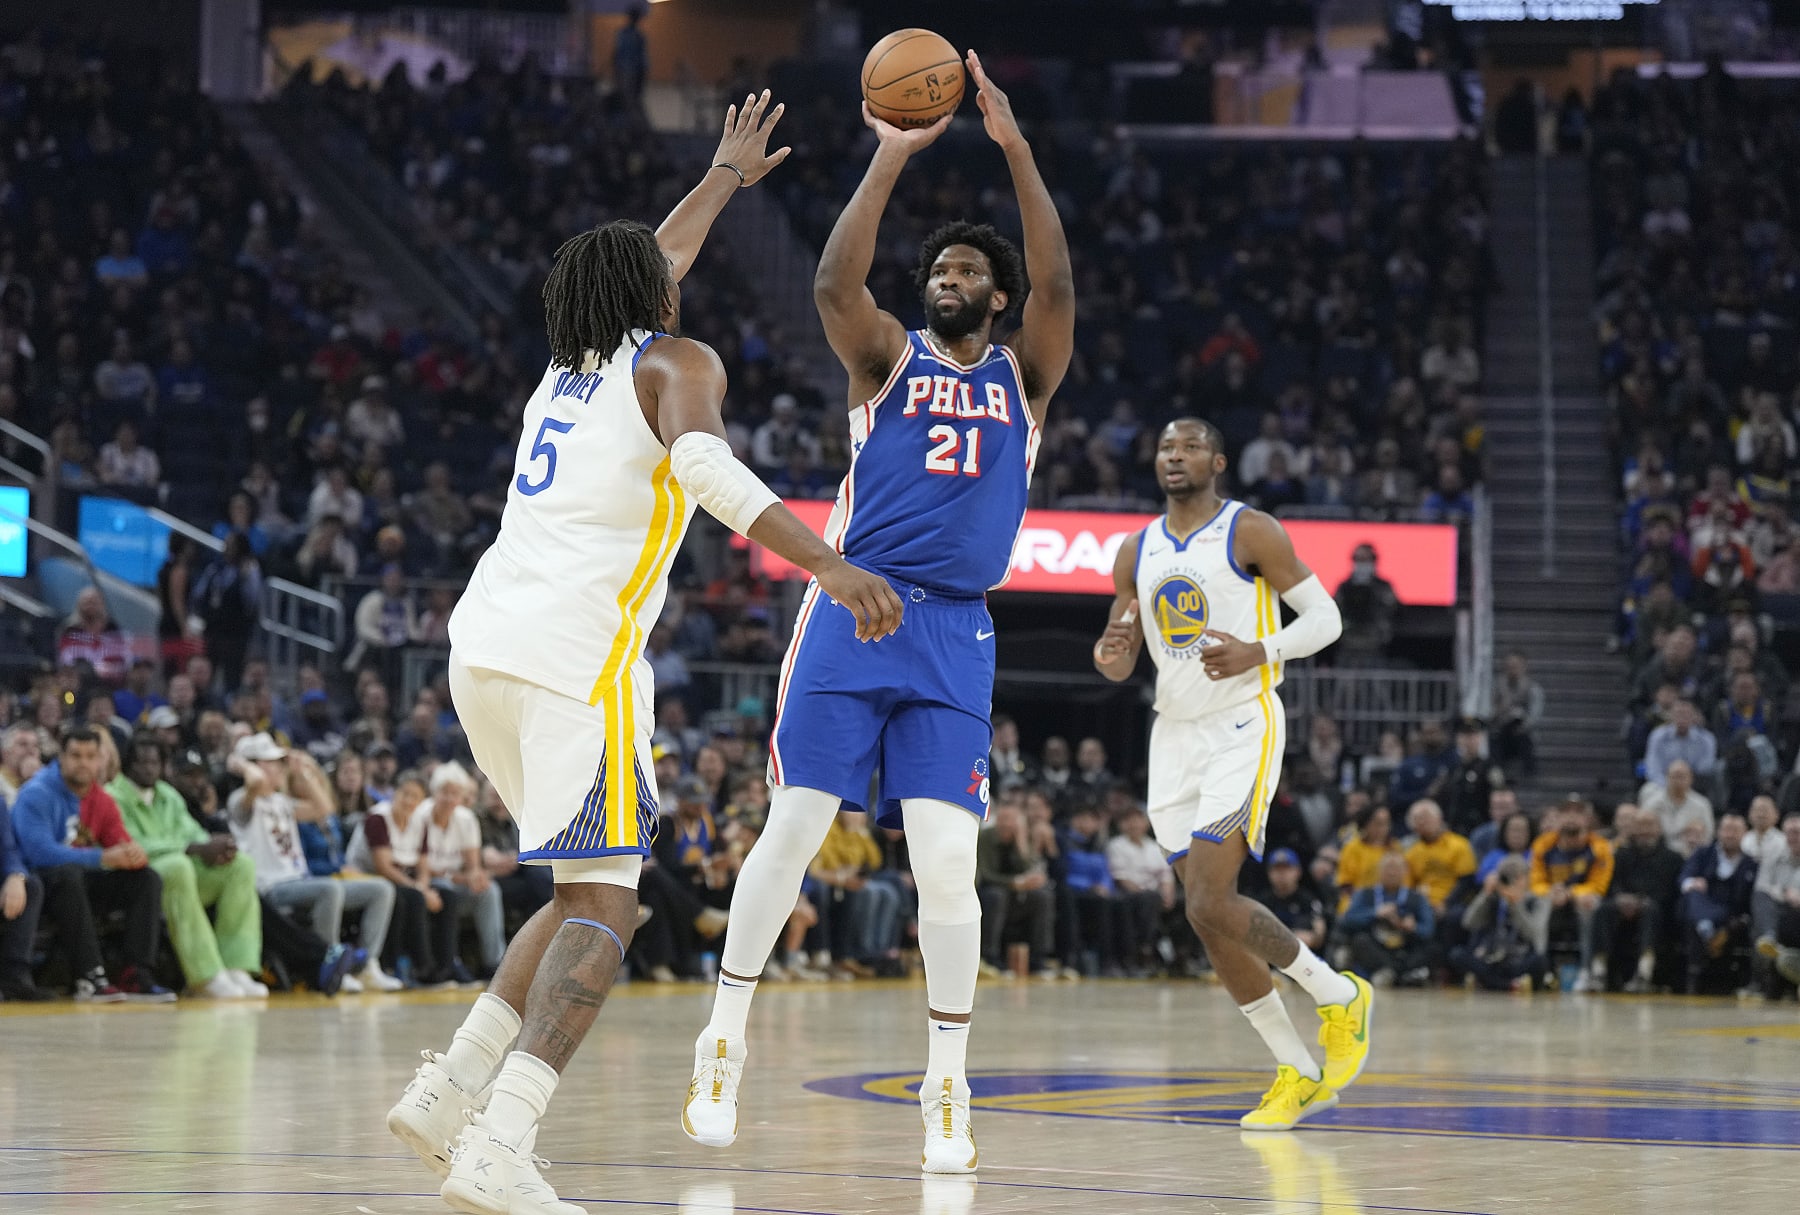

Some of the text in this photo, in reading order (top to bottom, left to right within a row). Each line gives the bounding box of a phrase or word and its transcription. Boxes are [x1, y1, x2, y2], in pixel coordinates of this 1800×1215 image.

[903, 375, 1012, 426] PHLA
[516, 417, 577, 497] 5
[925, 424, 981, 477] 21
[1177, 590, 1200, 613] 00
